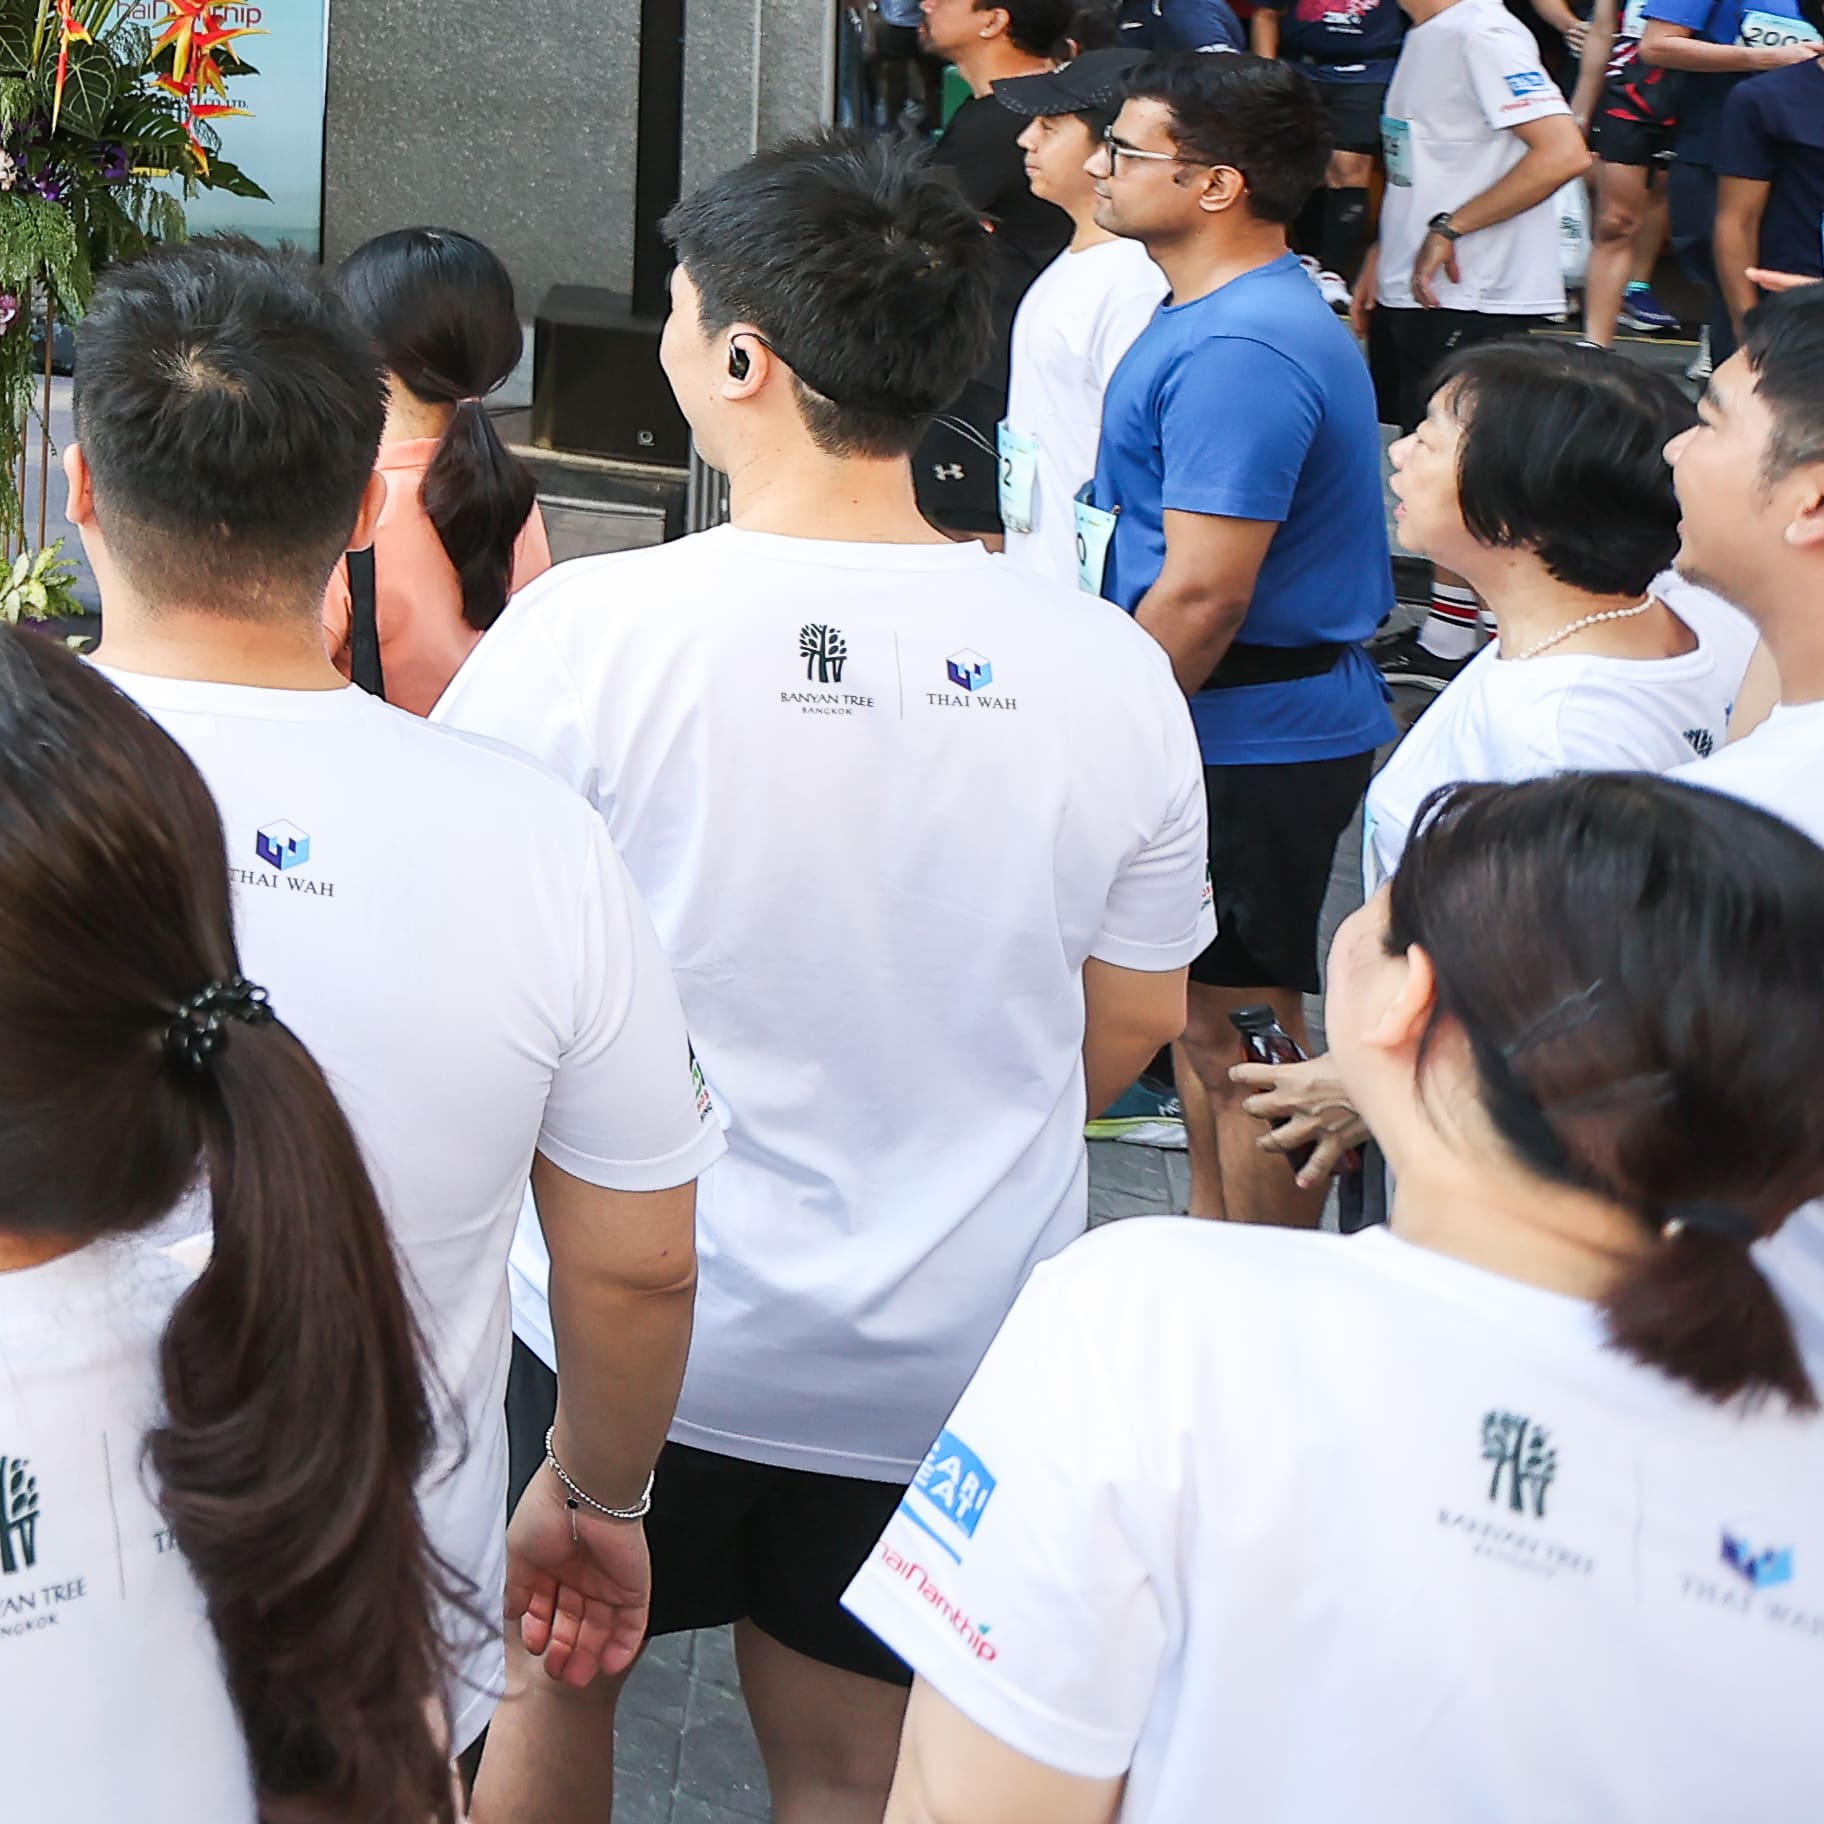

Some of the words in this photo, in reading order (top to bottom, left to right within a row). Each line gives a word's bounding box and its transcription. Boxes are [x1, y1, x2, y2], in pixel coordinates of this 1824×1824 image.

[780, 692, 839, 704] BANYAN
[843, 695, 875, 707] TREE
[926, 693, 970, 707] THAI
[977, 696, 1017, 710] WAH
[801, 707, 852, 716] BANGKOK
[228, 868, 278, 888] THAI
[287, 877, 335, 896] WAH
[41, 1578, 87, 1605] TREE
